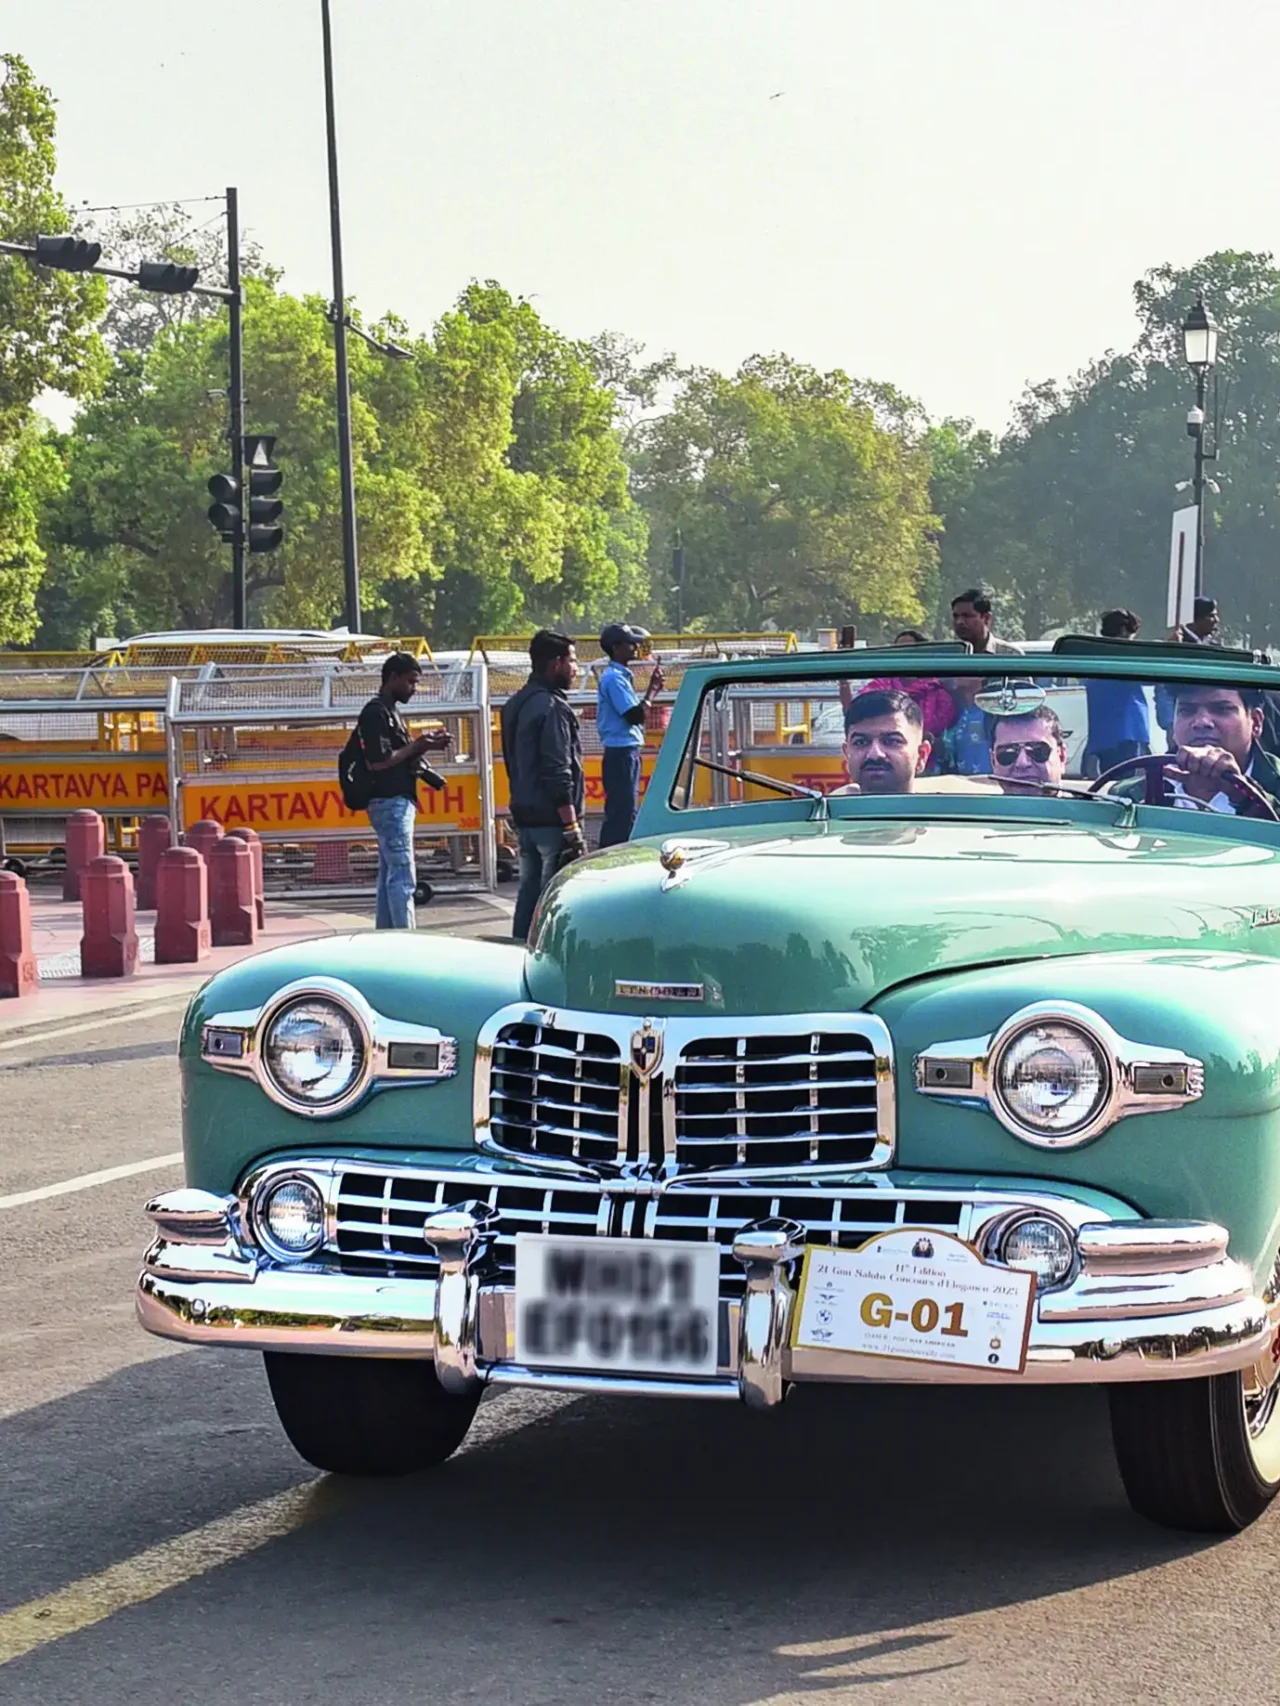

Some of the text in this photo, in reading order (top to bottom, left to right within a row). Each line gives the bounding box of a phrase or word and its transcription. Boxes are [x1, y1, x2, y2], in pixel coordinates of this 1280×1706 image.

[0, 772, 169, 799] KARTAVYA PA
[200, 785, 465, 823] KARTAVY TH
[817, 1264, 829, 1275] 21
[832, 1265, 852, 1277] Gun
[854, 1268, 887, 1281] Salute
[889, 1272, 935, 1286] Concours
[860, 1292, 969, 1338] G-01
